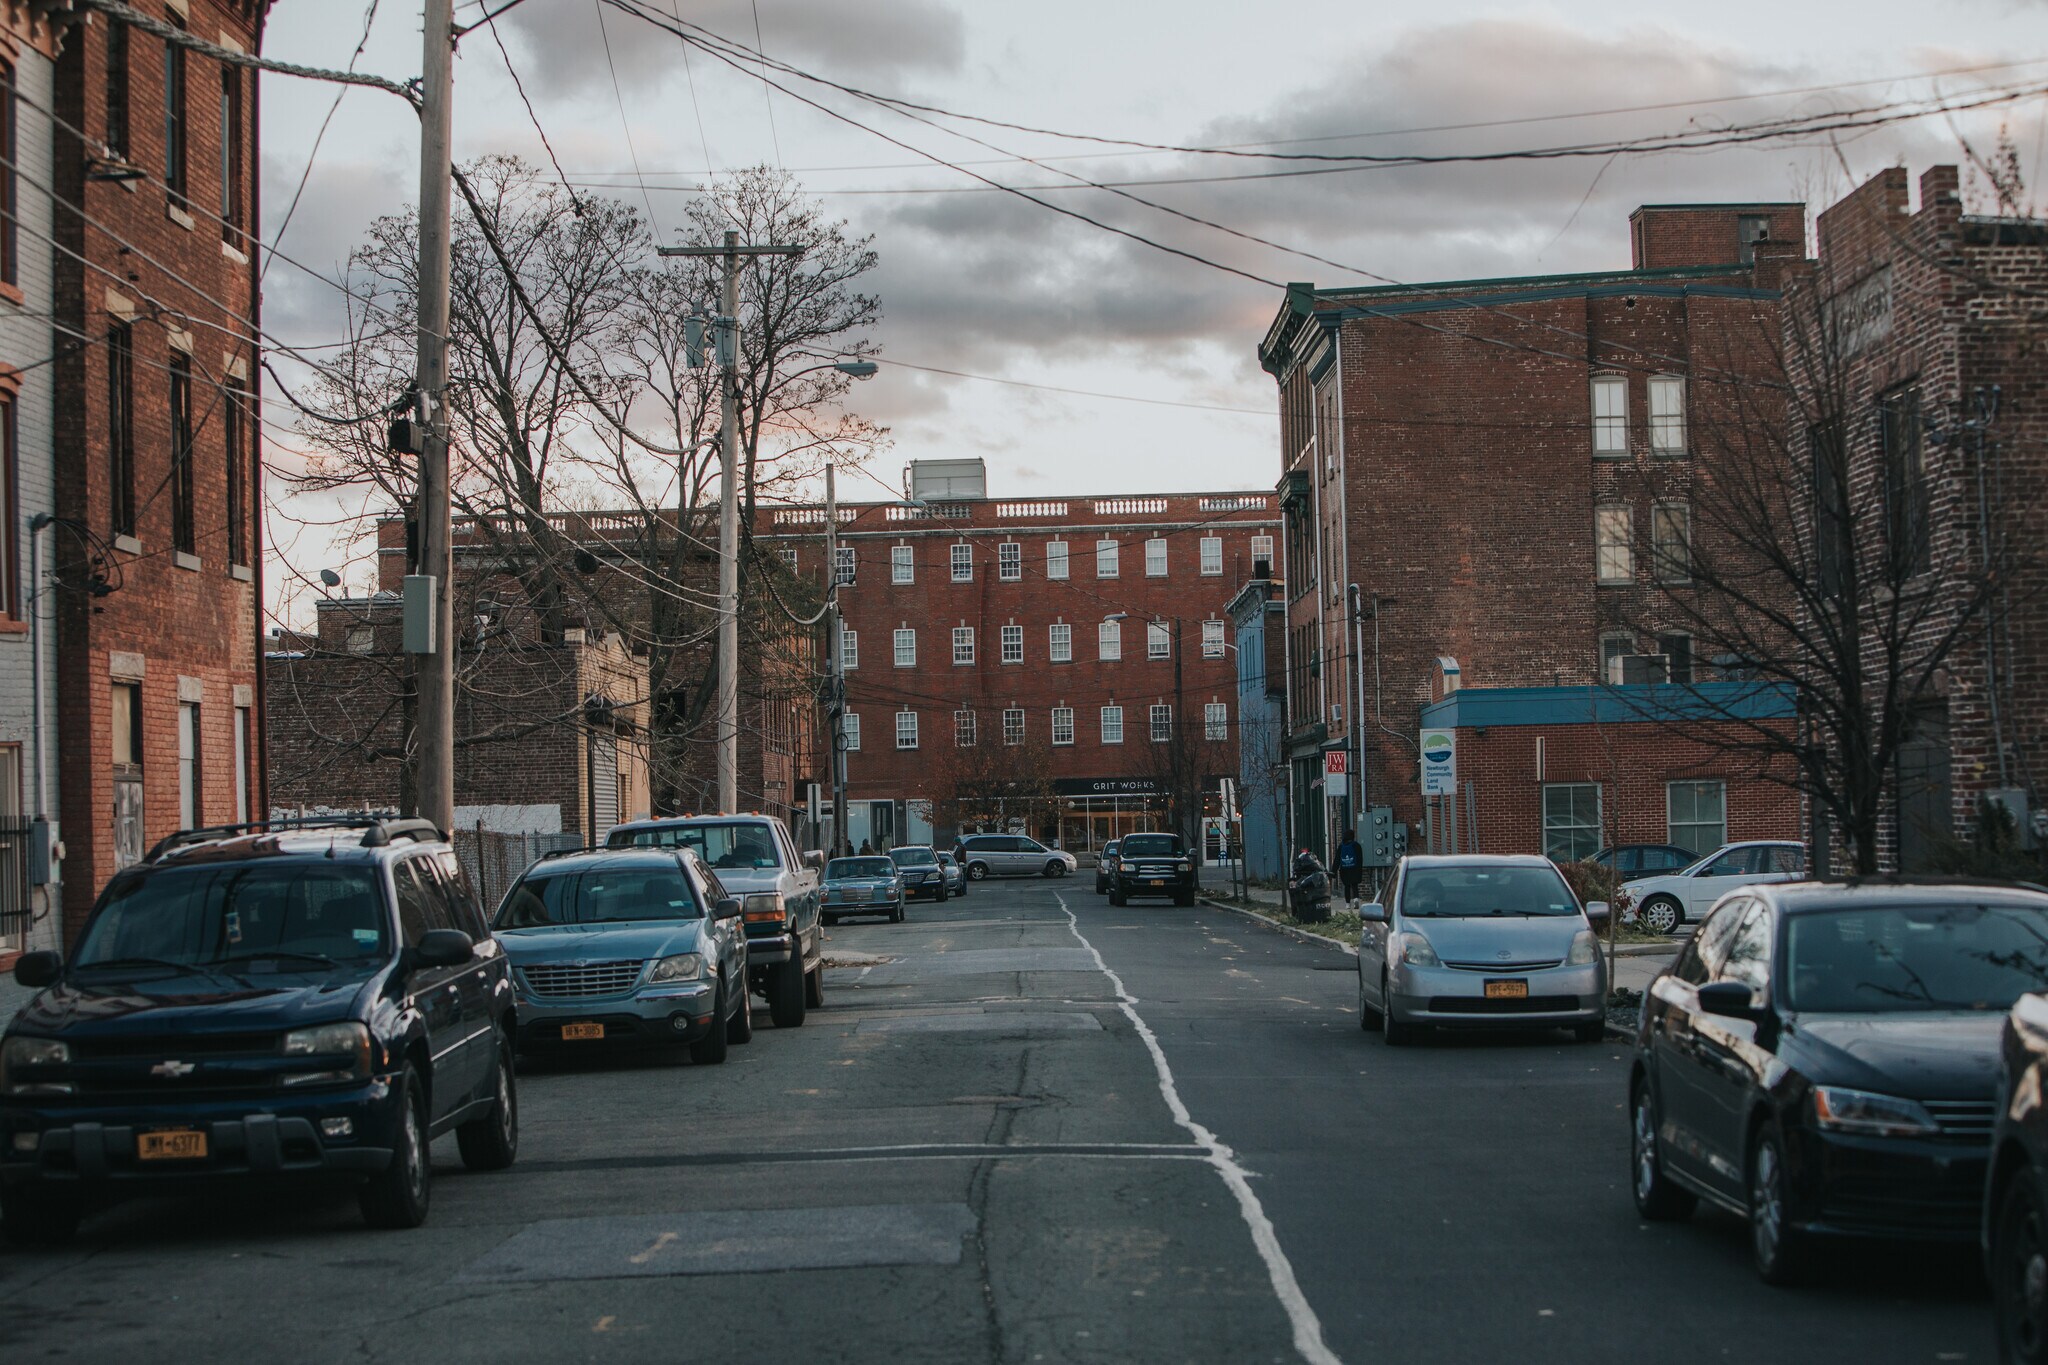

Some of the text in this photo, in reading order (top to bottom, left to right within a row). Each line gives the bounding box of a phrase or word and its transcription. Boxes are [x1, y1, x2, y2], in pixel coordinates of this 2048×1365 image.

[1328, 754, 1344, 767] JW
[1331, 764, 1344, 772] RA
[1093, 781, 1155, 790] GRIT WORKS
